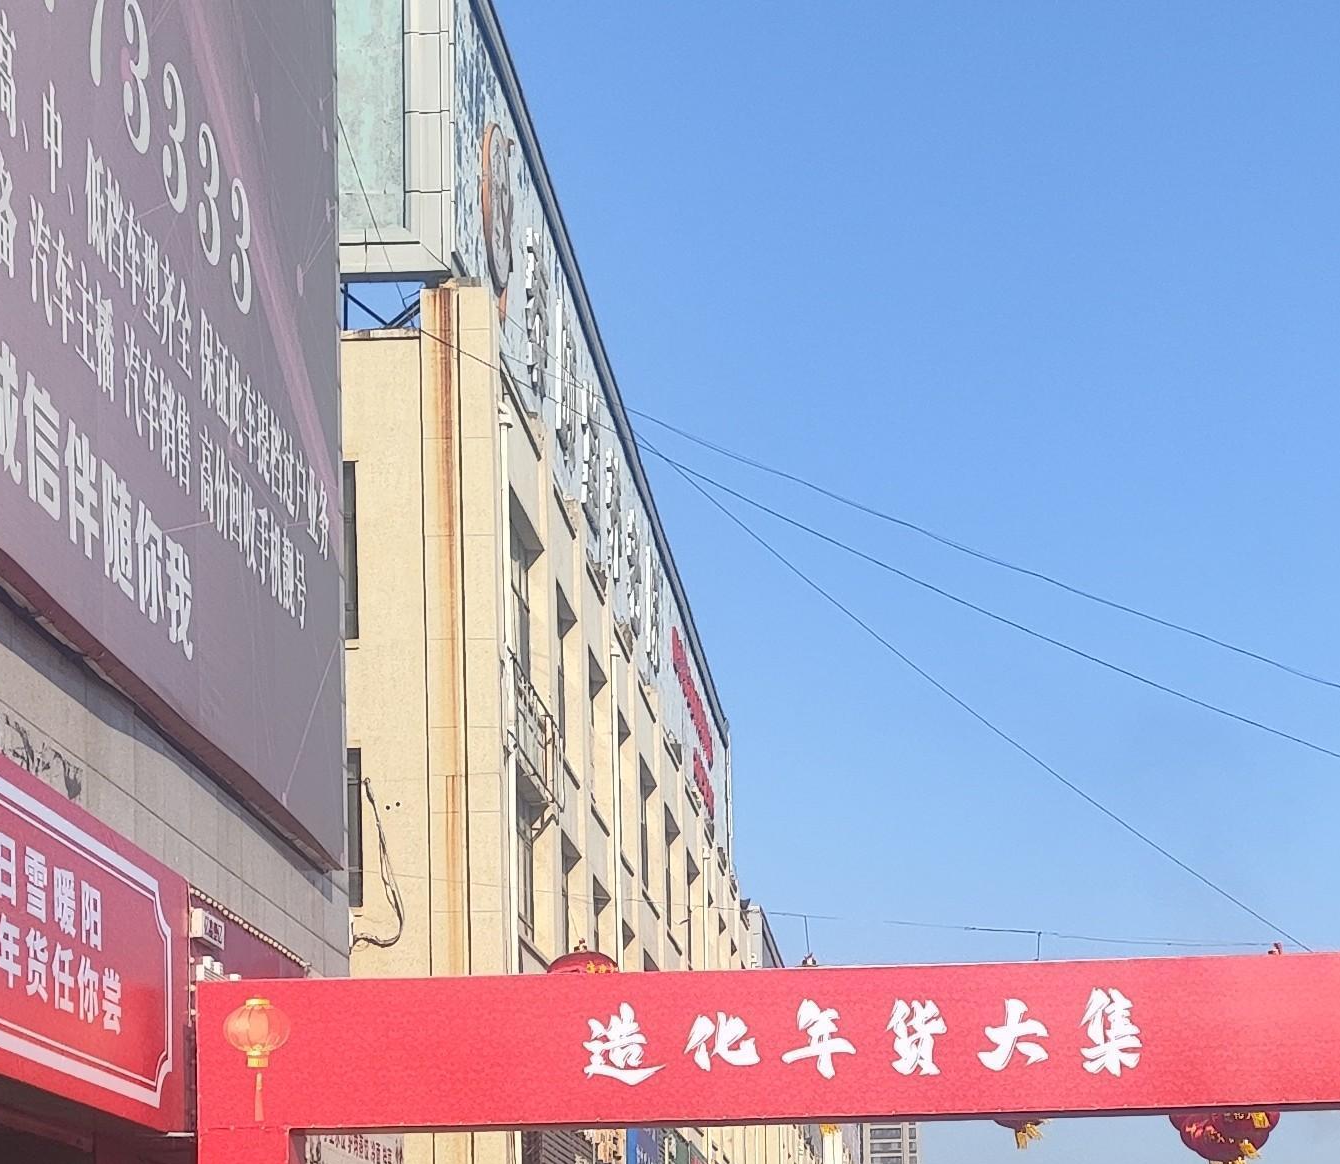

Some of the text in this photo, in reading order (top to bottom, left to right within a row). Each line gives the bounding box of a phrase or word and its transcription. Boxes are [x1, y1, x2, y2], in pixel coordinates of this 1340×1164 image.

[29, 194, 114, 402] 汽车主播
[123, 321, 191, 495] 汽车销售
[582, 987, 1144, 1086] 造化年货大集
